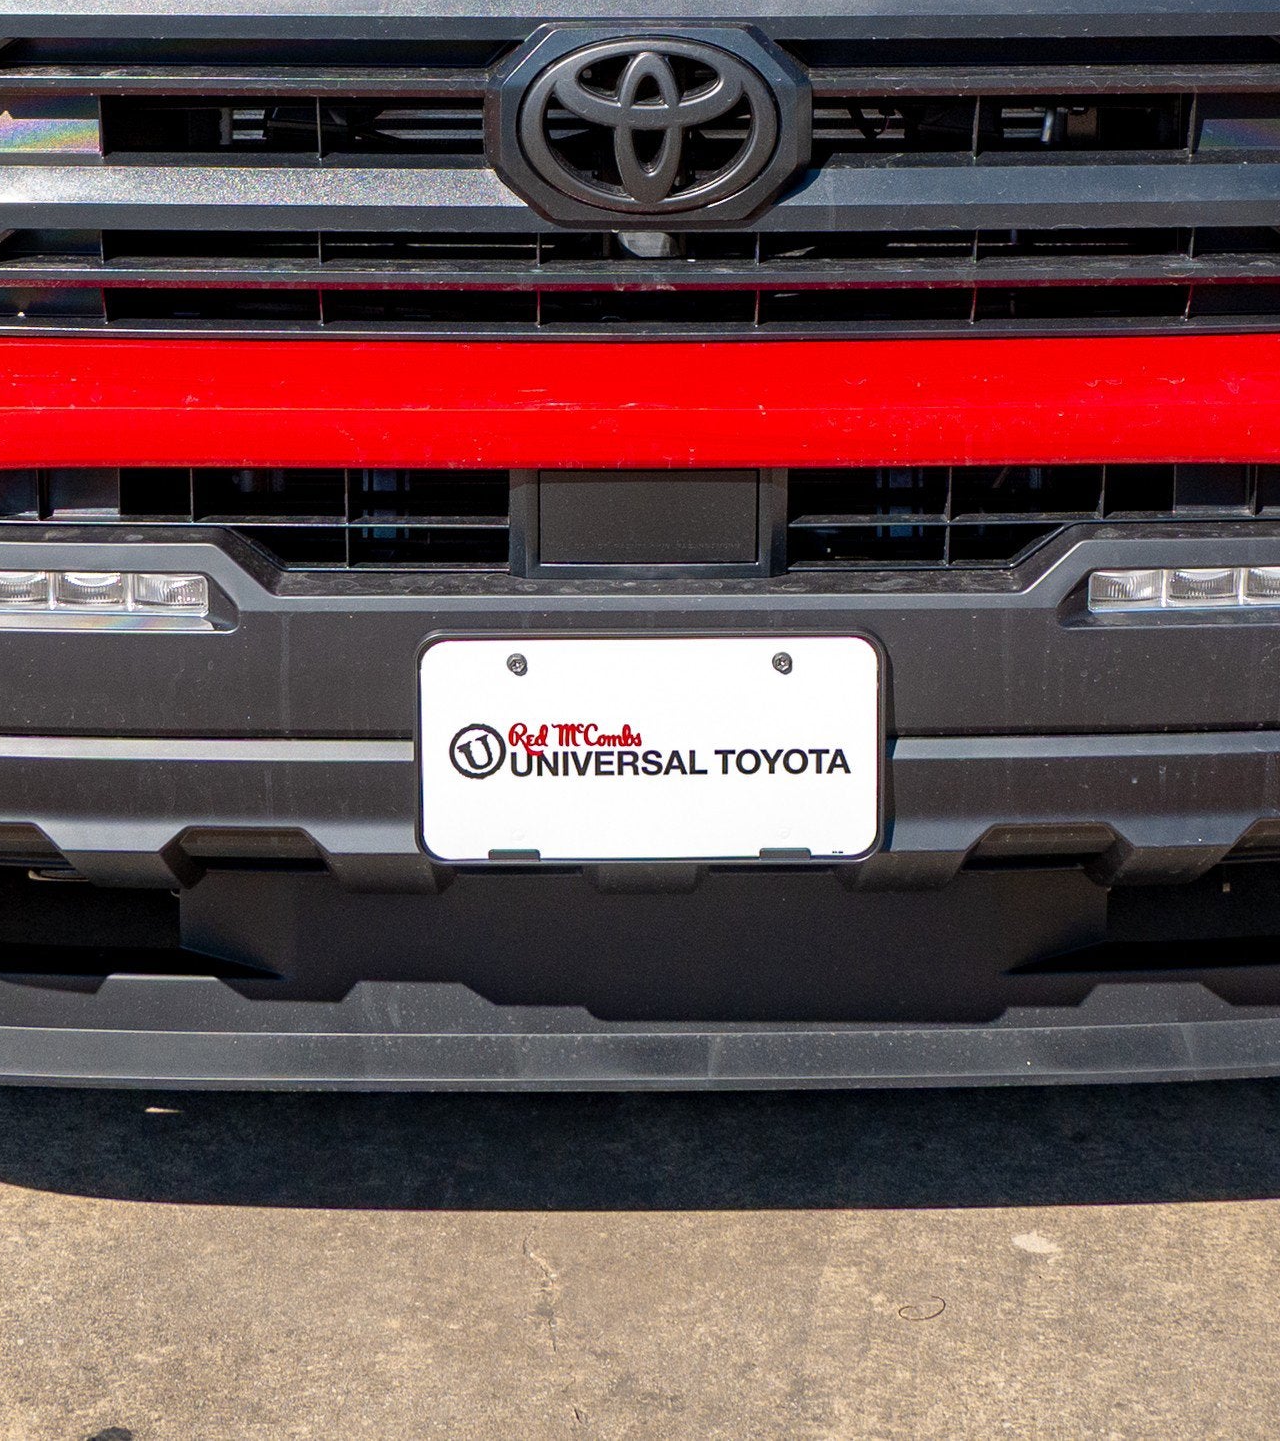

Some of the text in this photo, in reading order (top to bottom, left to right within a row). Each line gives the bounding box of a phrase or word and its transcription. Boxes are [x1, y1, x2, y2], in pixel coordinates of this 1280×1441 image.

[509, 723, 642, 756] Red McCombs
[511, 748, 851, 777] UNIVERSAL TOYOTA
